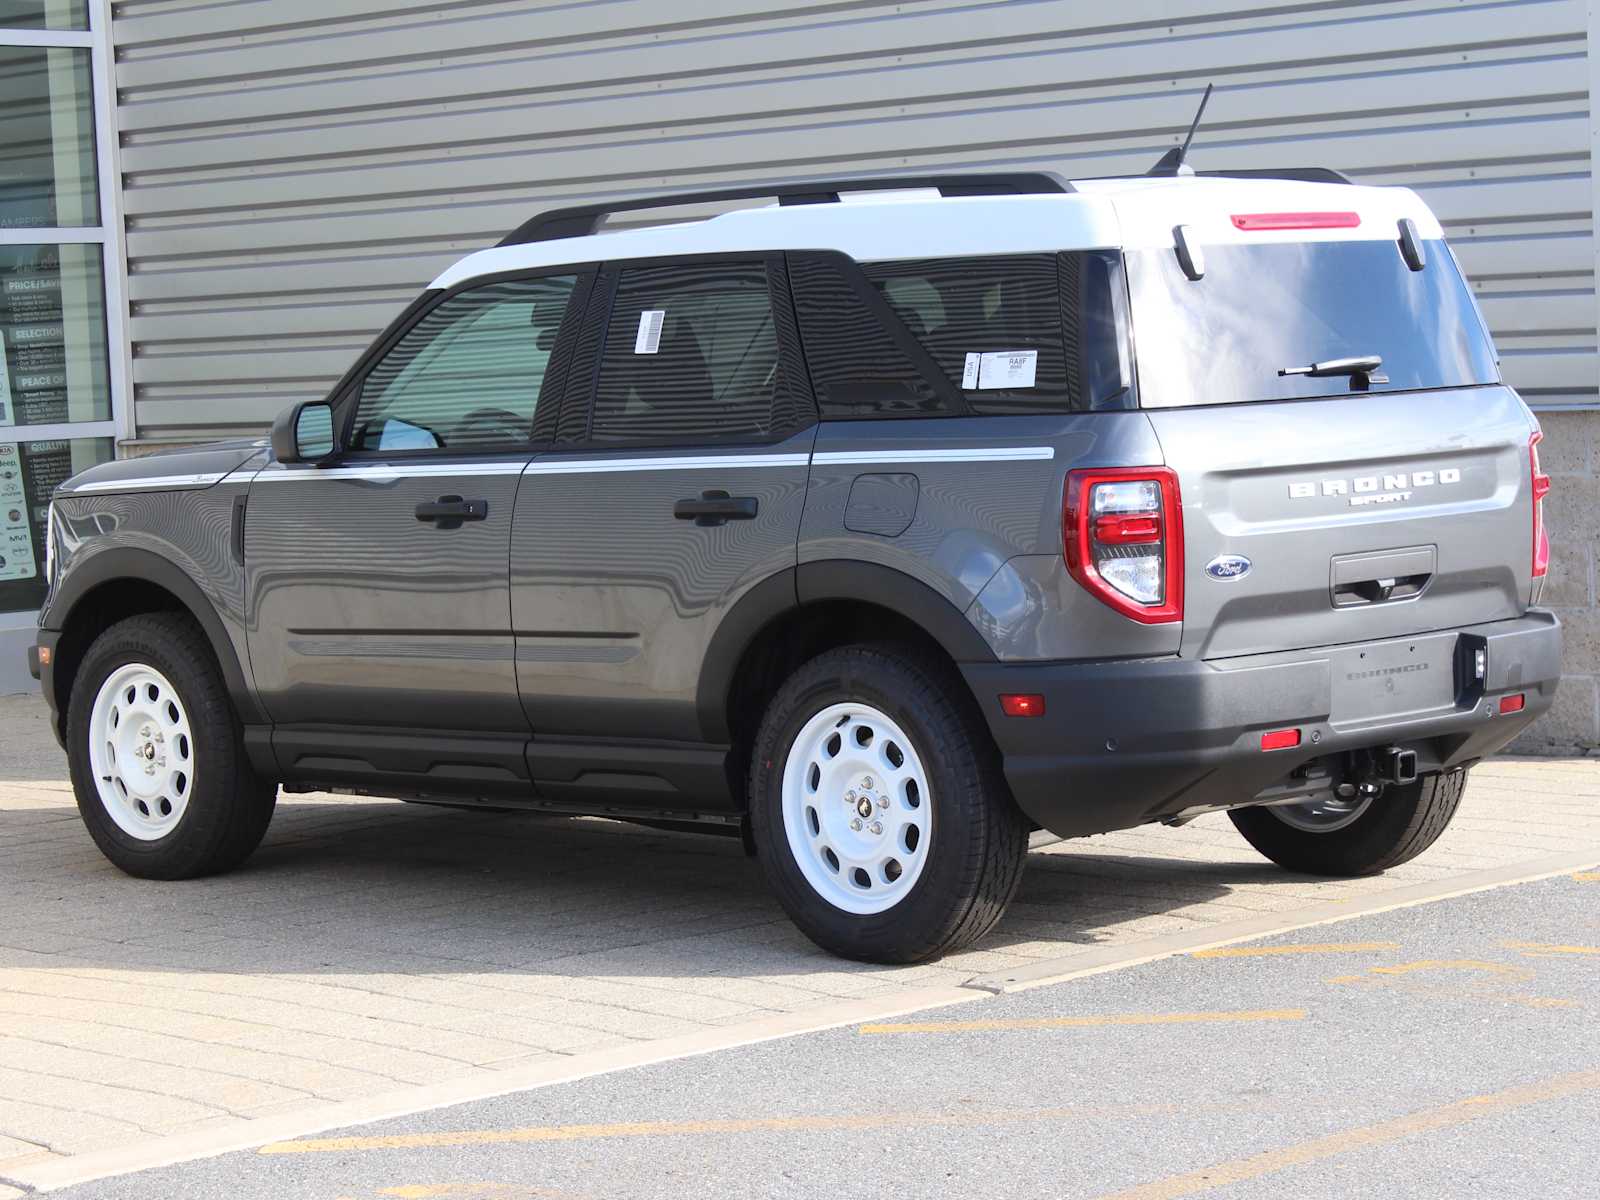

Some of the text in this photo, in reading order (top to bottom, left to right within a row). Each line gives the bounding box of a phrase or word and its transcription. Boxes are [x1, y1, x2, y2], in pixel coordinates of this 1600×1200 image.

[16, 328, 62, 339] SELECTION
[22, 376, 51, 387] PEACE
[1288, 468, 1461, 499] BRONCO
[1348, 491, 1413, 506] SPORT
